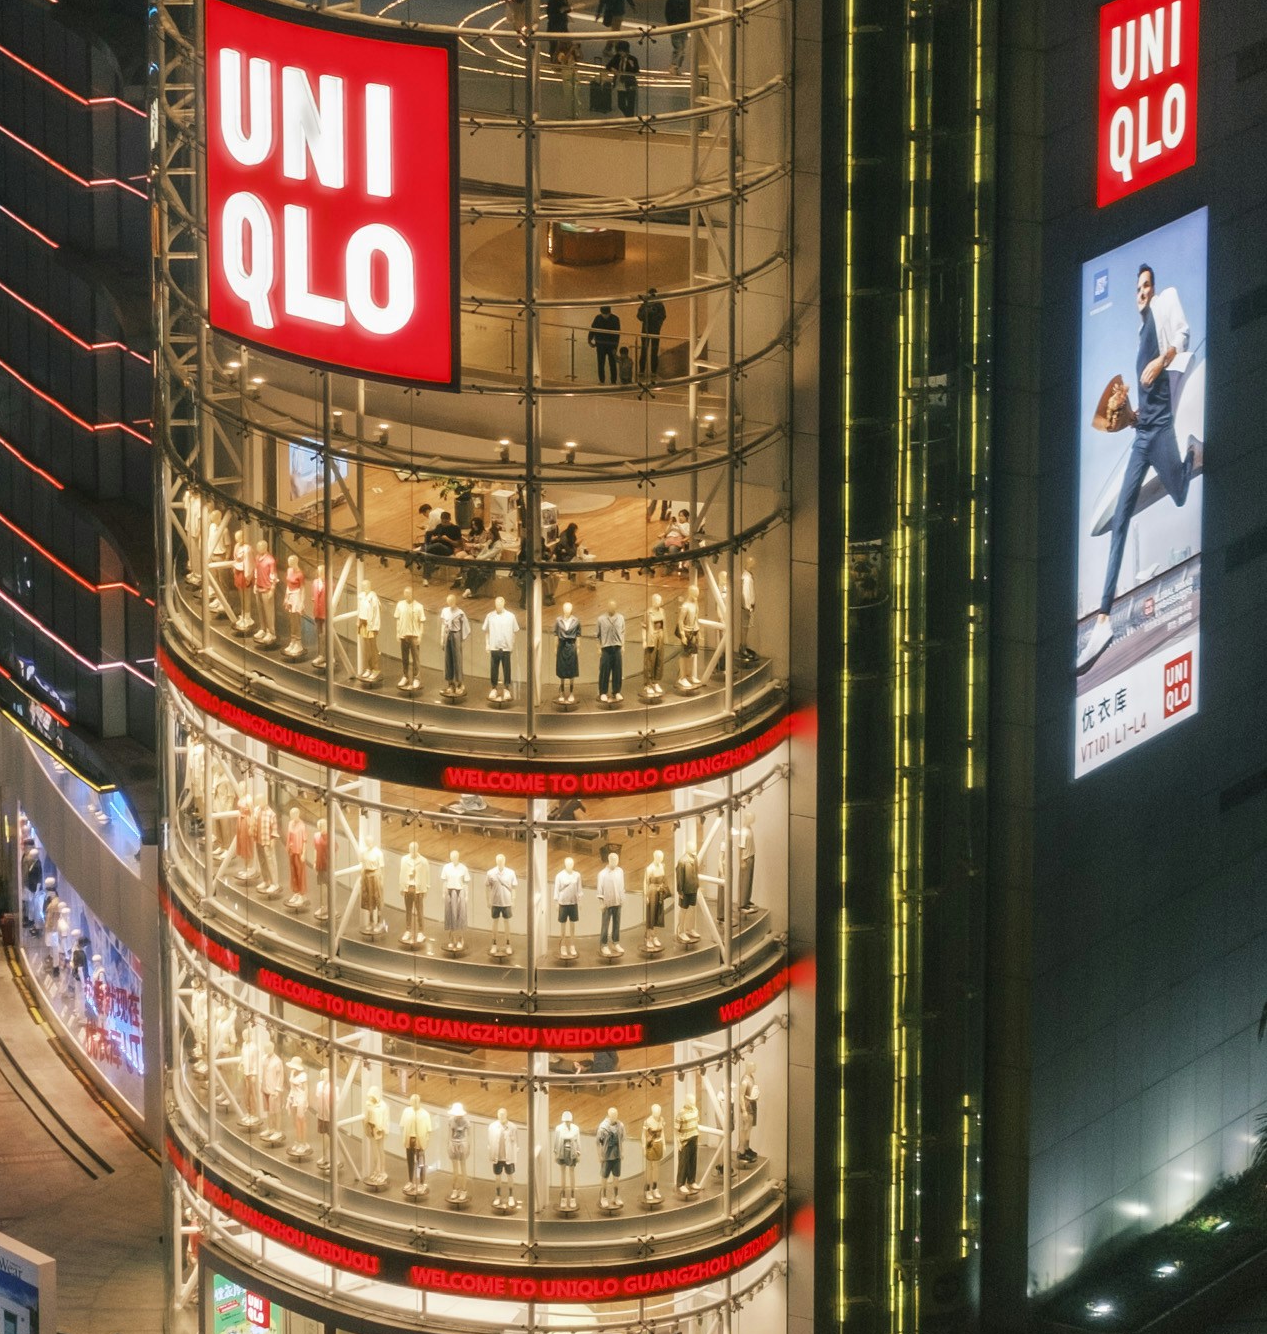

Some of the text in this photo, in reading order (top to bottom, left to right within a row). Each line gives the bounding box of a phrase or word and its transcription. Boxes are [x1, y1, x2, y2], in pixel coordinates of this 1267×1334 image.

[1111, 0, 1182, 91] UNI
[219, 47, 393, 198] UNI
[1109, 83, 1186, 182] QLO
[221, 191, 415, 335] QLO
[1166, 660, 1188, 687] UNI
[1166, 682, 1190, 712] QLO
[1082, 688, 1128, 734] 优衣库
[220, 700, 293, 746] GUANGZHOU
[294, 732, 367, 771] WEIDUOLI
[1080, 733, 1111, 763] VT101
[445, 744, 755, 794] WELCOME TO UNIQLO GUANGZHOU
[258, 967, 643, 1046] WELCOME TO UNIQLO GUANGZHOU WEIDUOLI
[306, 1233, 381, 1276] WEIDUOLI
[410, 1265, 506, 1296] WELCOME
[508, 1276, 537, 1297] TO
[541, 1276, 619, 1299] UNIQLO
[623, 1252, 731, 1294] GUANGZHOU
[247, 1293, 264, 1312] UNI
[247, 1309, 265, 1324] QLO
